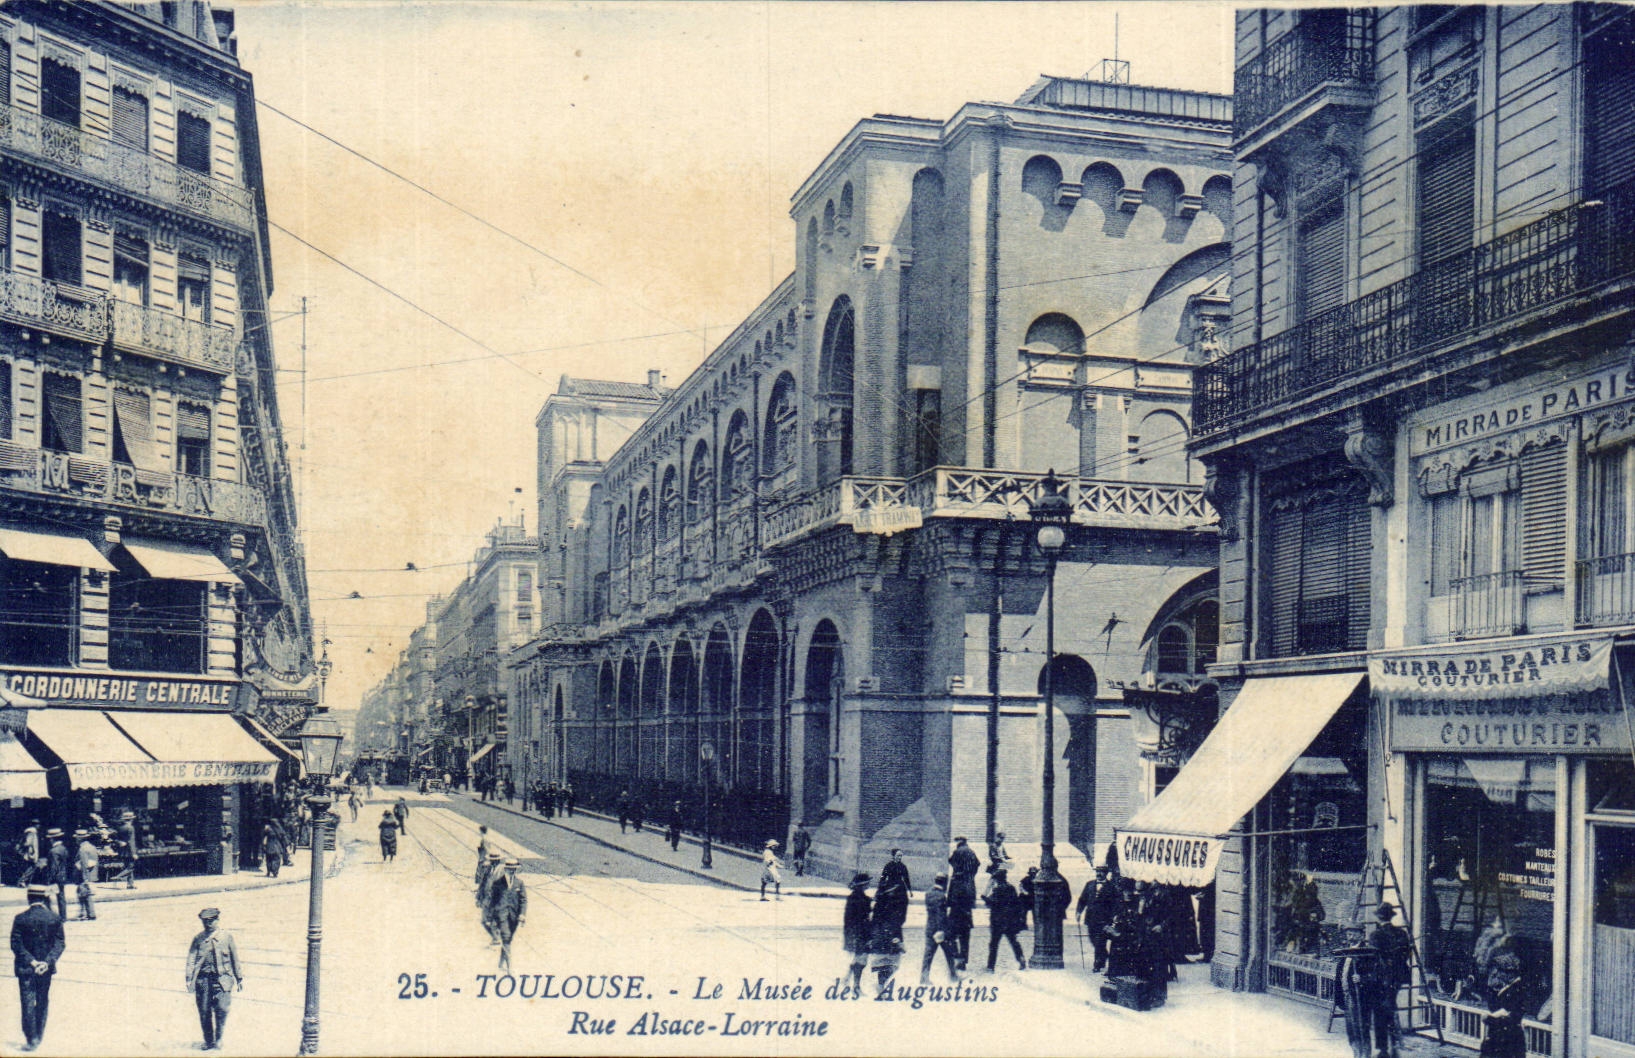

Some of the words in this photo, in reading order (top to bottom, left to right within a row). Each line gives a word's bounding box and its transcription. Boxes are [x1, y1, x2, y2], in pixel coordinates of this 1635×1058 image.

[1425, 409, 1499, 448] MIRRA
[1506, 404, 1532, 426] DE
[1541, 369, 1635, 417] PARIS
[1382, 659, 1459, 676] MIRRA
[1465, 659, 1492, 675] DE
[1501, 643, 1592, 672] PARIS
[10, 674, 138, 702] CORDONNERIE
[146, 681, 231, 705] CENTRALE
[1418, 668, 1542, 687] COUTURIER
[1440, 722, 1601, 746] COUTURIER
[73, 763, 187, 780] CORDONNERIE
[193, 763, 272, 778] CENTRALE
[1124, 836, 1208, 868] CHAUSSURES
